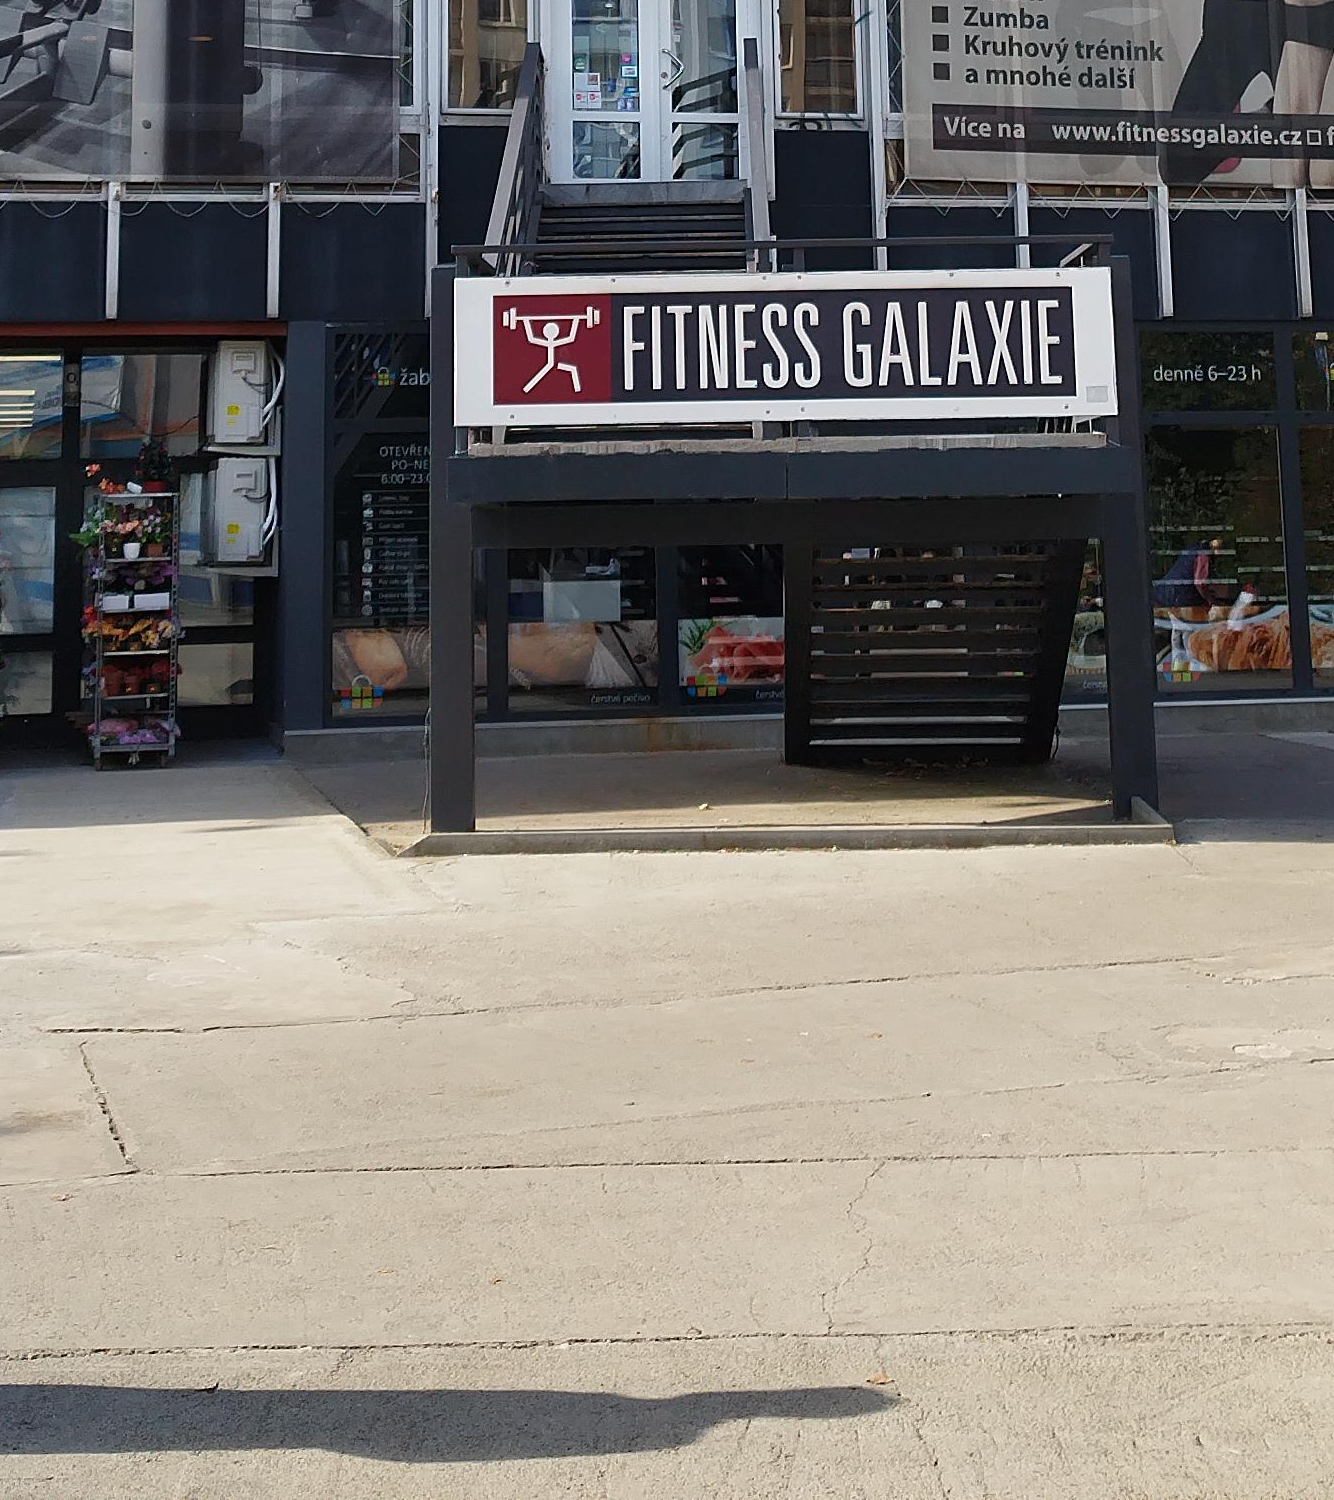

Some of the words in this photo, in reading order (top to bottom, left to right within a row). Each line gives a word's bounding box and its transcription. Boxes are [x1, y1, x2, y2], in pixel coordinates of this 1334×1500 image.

[963, 6, 1049, 30] Zumba
[964, 34, 1069, 64] Kruhový
[1075, 38, 1164, 62] trénink
[965, 68, 979, 84] a
[986, 65, 1071, 87] mnohé
[1078, 66, 1136, 89] další
[944, 115, 992, 139] Více
[997, 121, 1025, 139] na
[1052, 121, 1302, 149] www.fitnessgalaxie.cz
[622, 302, 821, 391] FITNESS
[842, 300, 1063, 388] GALAXIE
[399, 367, 430, 386] žab
[1153, 364, 1204, 381] denně
[1252, 365, 1262, 382] h
[379, 444, 430, 457] OTEVŘEN
